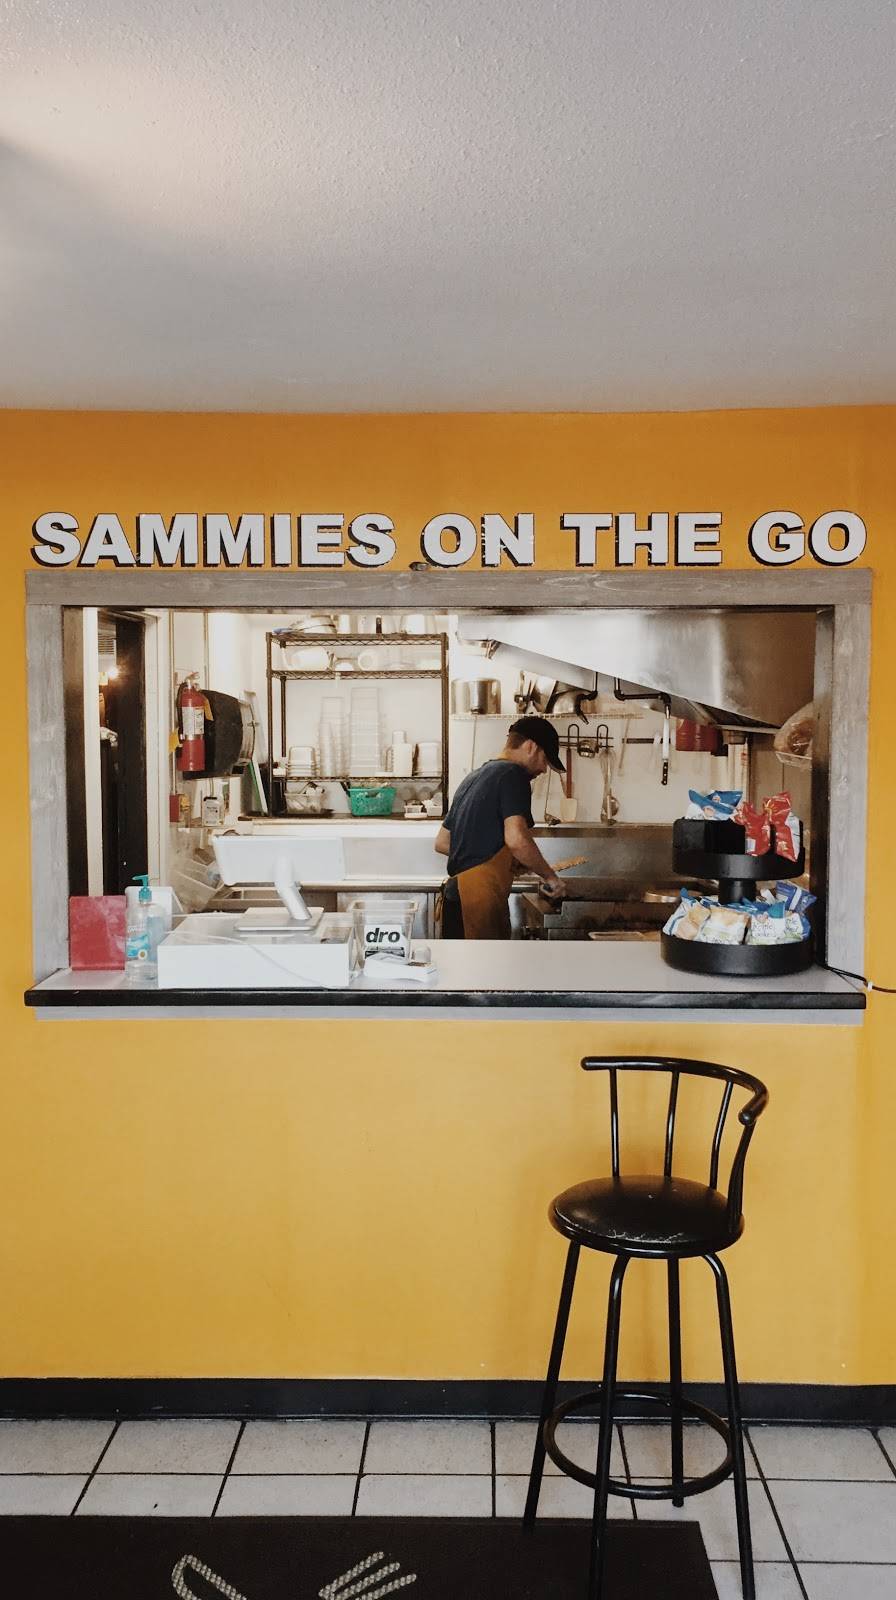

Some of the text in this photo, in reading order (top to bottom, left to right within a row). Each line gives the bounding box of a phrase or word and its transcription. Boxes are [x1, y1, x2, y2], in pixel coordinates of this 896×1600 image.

[32, 510, 867, 566] SAMMIES ON THE GO
[366, 928, 401, 943] dro
